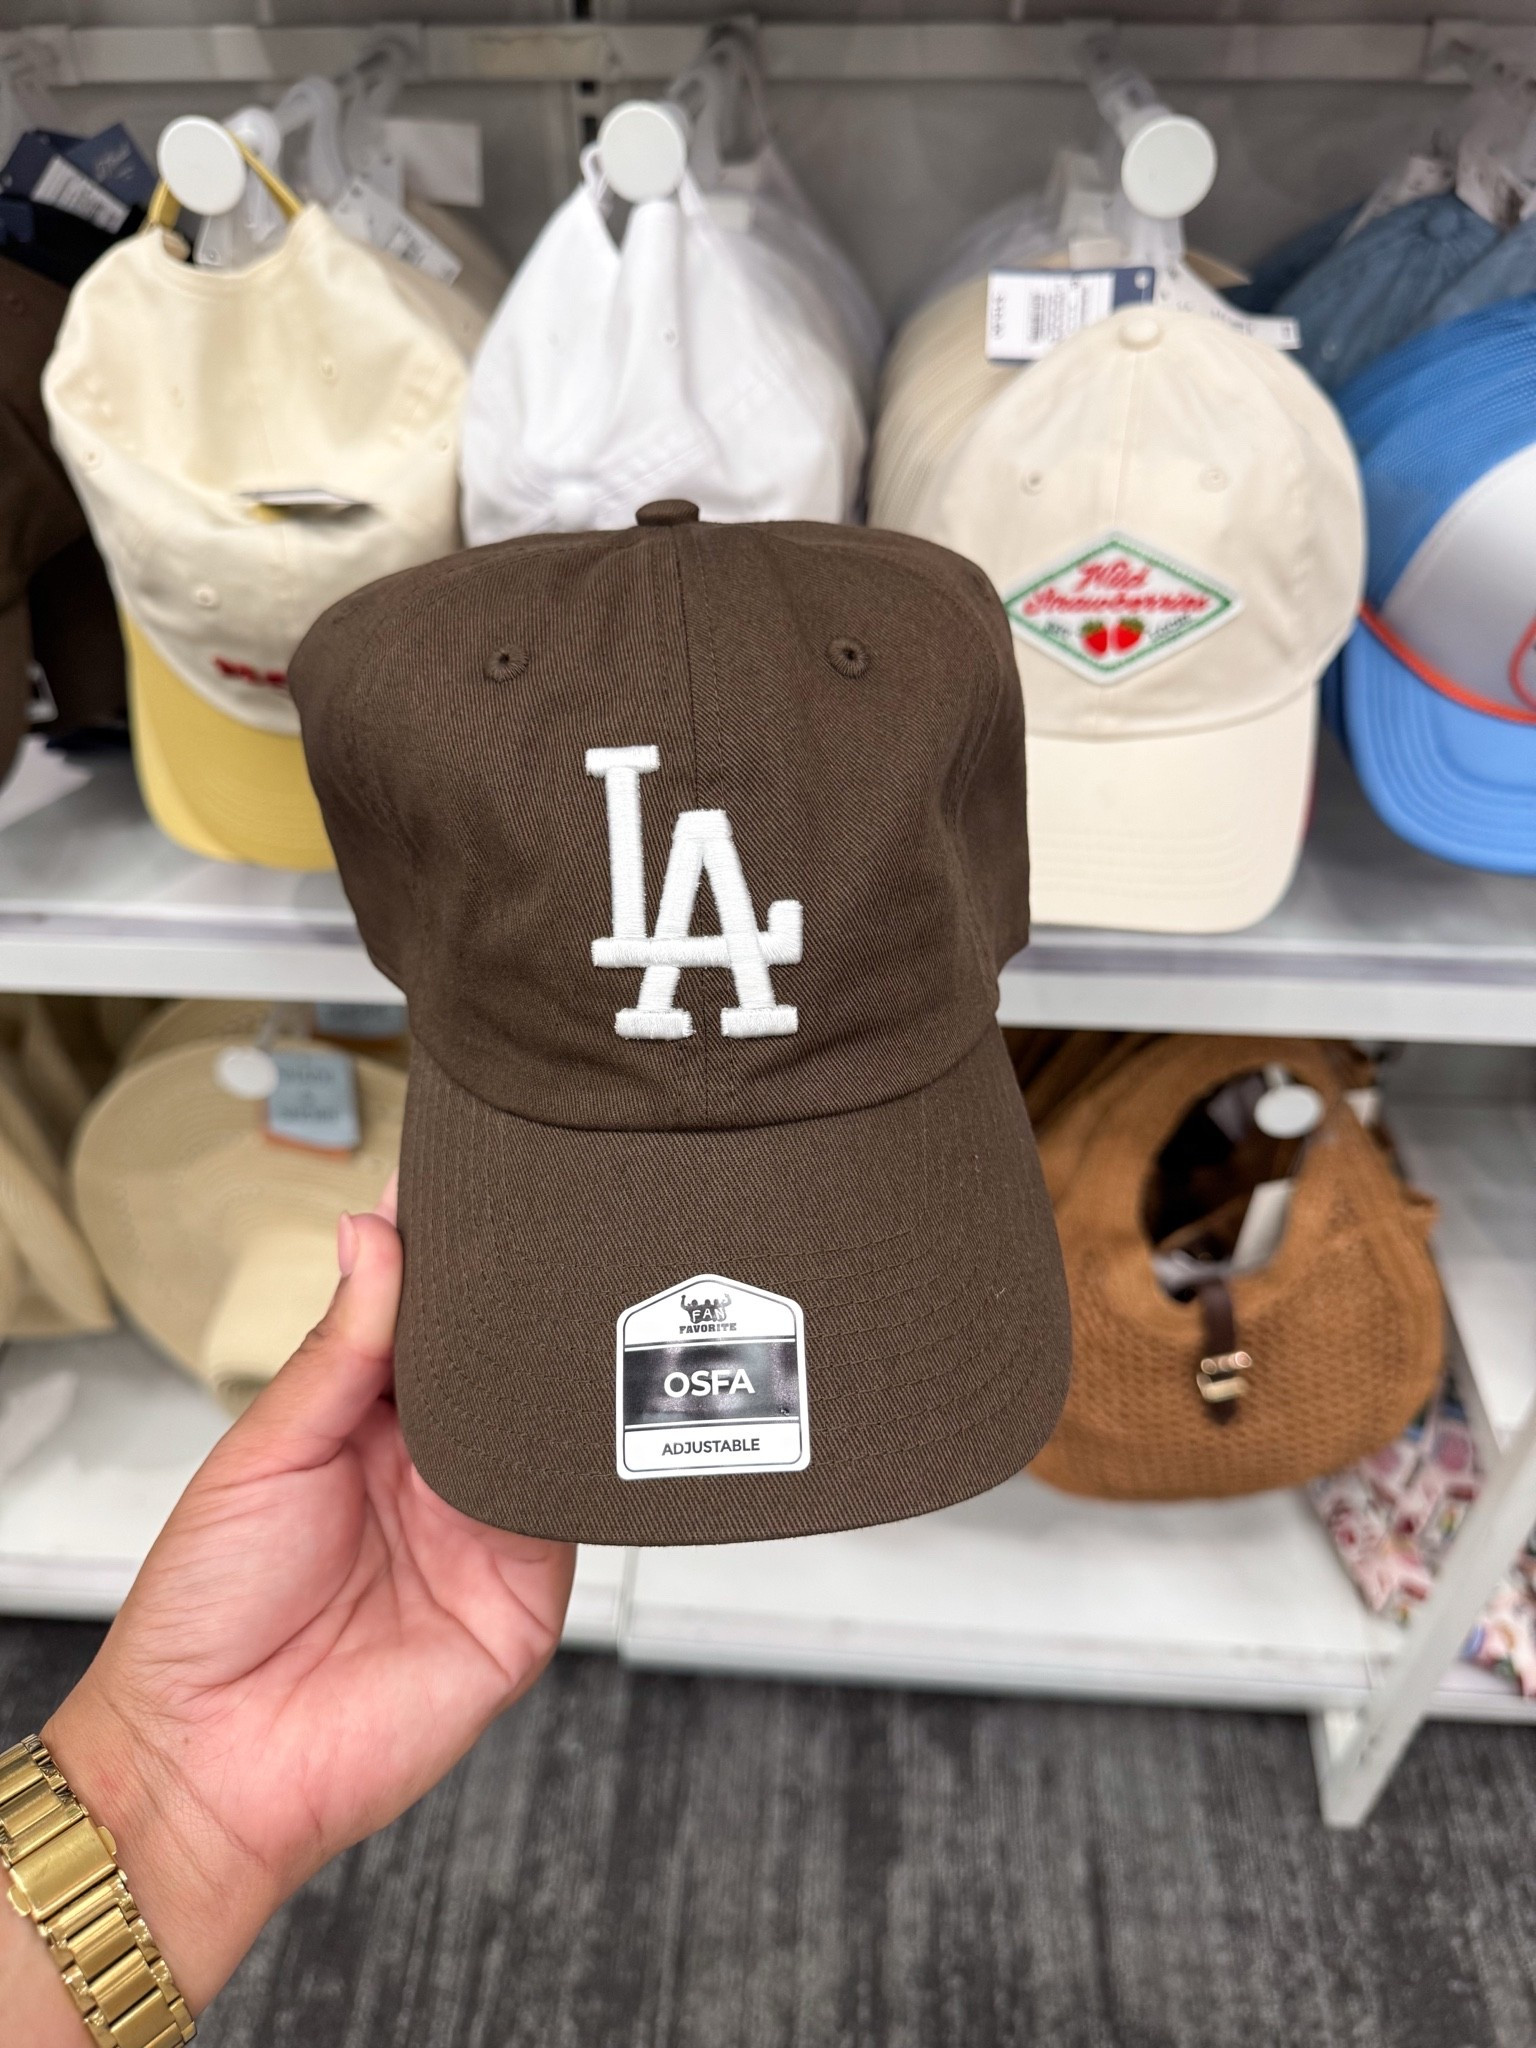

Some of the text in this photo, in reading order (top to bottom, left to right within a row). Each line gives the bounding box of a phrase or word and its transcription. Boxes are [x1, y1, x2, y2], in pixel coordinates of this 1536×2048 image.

[585, 745, 803, 1039] LA
[692, 1308, 726, 1322] FAN
[679, 1323, 737, 1334] FAVORITE
[664, 1369, 755, 1397] OSFA
[662, 1438, 760, 1456] ADJUSTABLE
